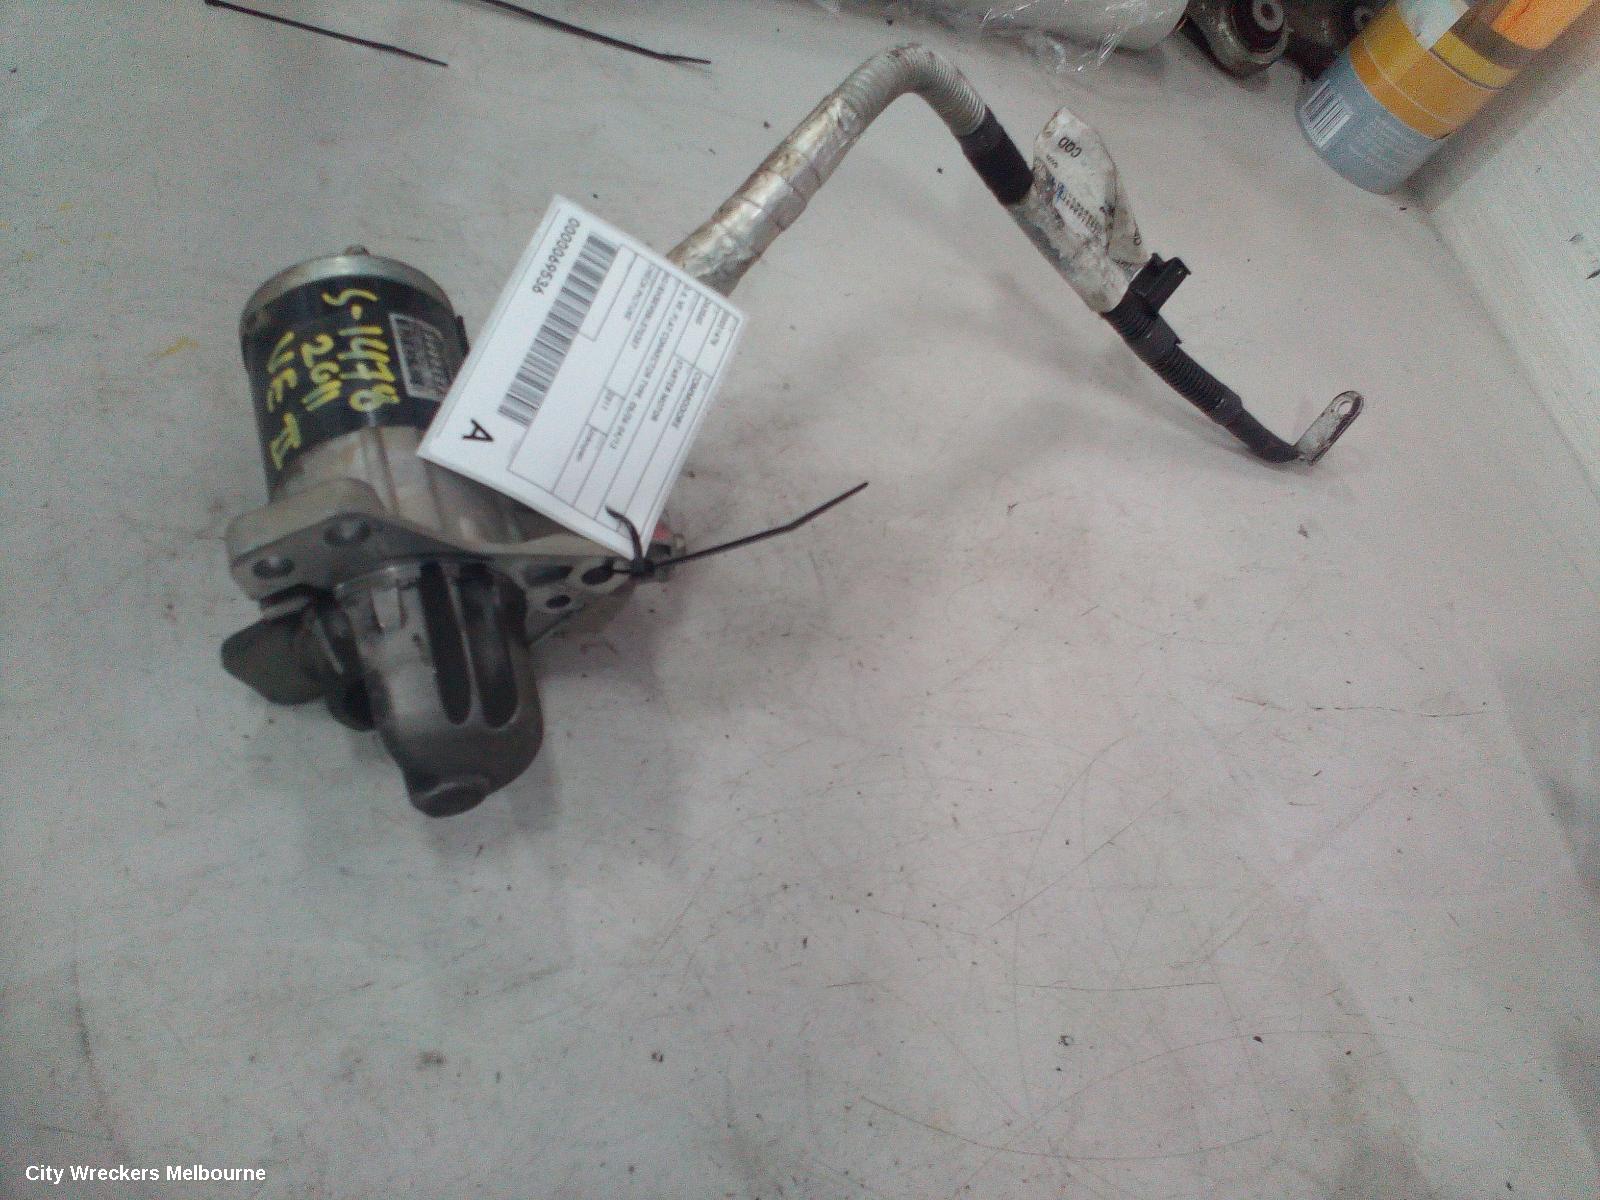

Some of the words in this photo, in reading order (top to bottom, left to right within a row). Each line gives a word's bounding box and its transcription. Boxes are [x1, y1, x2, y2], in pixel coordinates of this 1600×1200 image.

[1058, 136, 1083, 158] CQD
[531, 217, 580, 296] 0000069536
[663, 358, 684, 393] STARTER
[649, 391, 669, 423] MOTOR
[671, 370, 702, 429] COMMODORE
[462, 418, 494, 443] A
